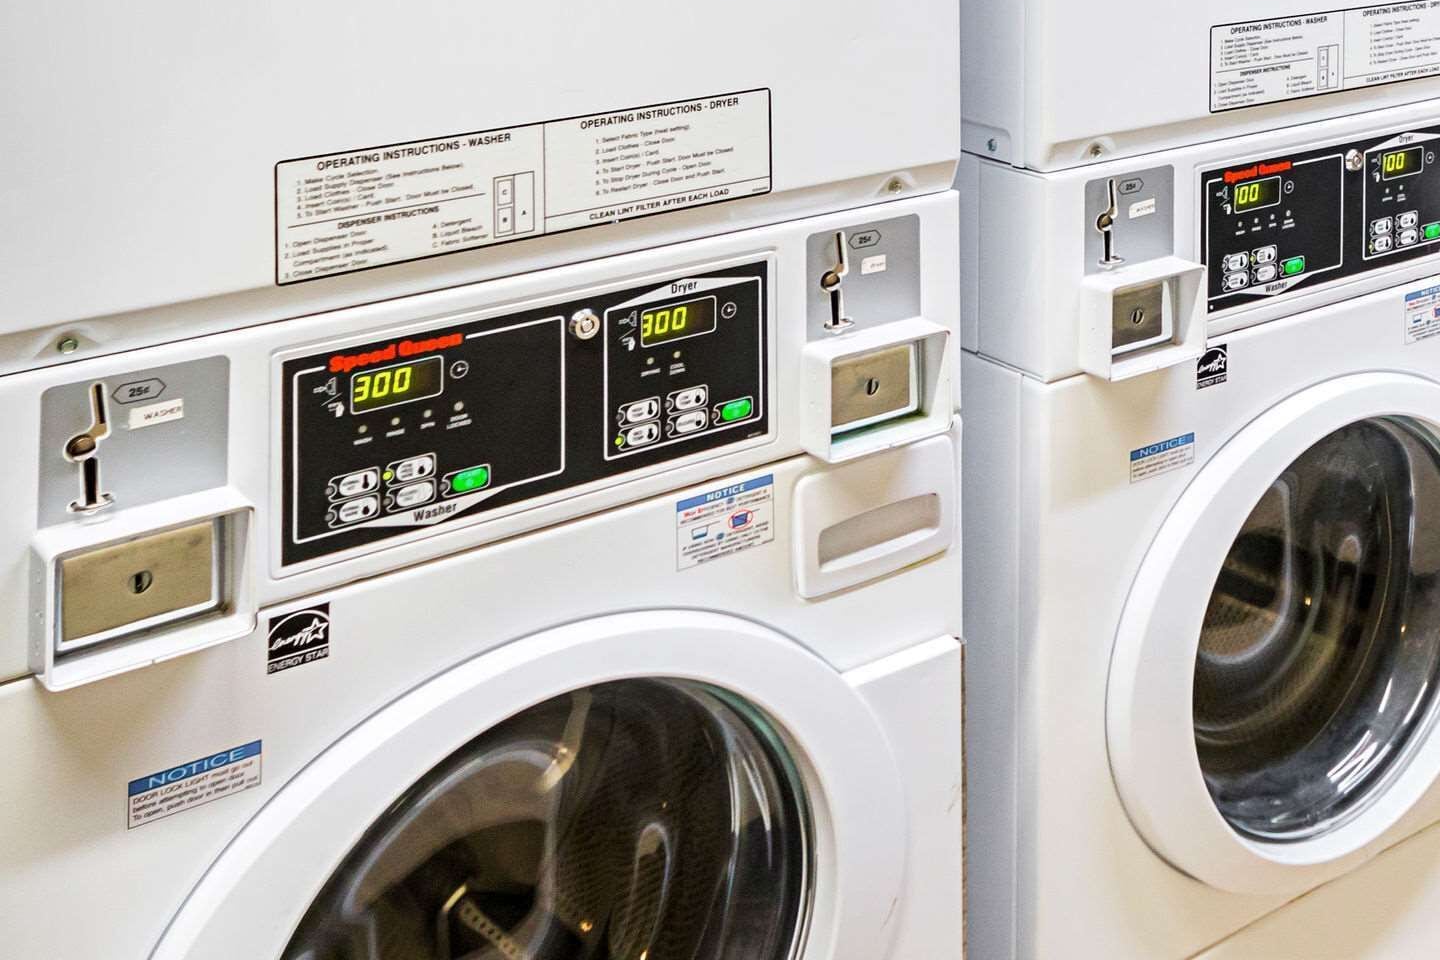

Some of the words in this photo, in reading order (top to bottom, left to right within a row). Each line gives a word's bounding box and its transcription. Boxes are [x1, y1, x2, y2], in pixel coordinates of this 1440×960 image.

[1230, 24, 1262, 35] OPERATING
[1263, 19, 1302, 30] INSTRUCTIONS
[580, 113, 634, 130] OPERATING
[637, 103, 702, 121] INSTRUCTIONS
[709, 97, 739, 110] DRYER
[317, 152, 380, 171] OPERATING
[383, 140, 460, 160] INSTRUCTIONS
[468, 132, 512, 147] WASHER
[337, 215, 382, 230] DISPENSER
[383, 206, 440, 221] INSTRUCTIONS
[589, 209, 616, 221] CLEAN
[617, 205, 634, 215] LINT
[636, 201, 661, 211] FILTER
[662, 195, 687, 206] AFTER
[688, 193, 708, 202] EACH
[709, 188, 729, 198] LOAD
[671, 280, 698, 295] Dryer
[1264, 279, 1288, 293] Washer
[642, 306, 688, 338] 300
[329, 343, 397, 373] Speed
[353, 366, 413, 403] 300
[1140, 437, 1186, 458] NOTICE
[706, 483, 745, 502] NOTICE
[412, 502, 457, 523] Washer
[305, 647, 329, 662] STAR
[148, 747, 245, 789] NOTICE
[133, 792, 158, 805] DOOR
[160, 784, 184, 796] LOCK
[185, 775, 209, 788] LIGHT
